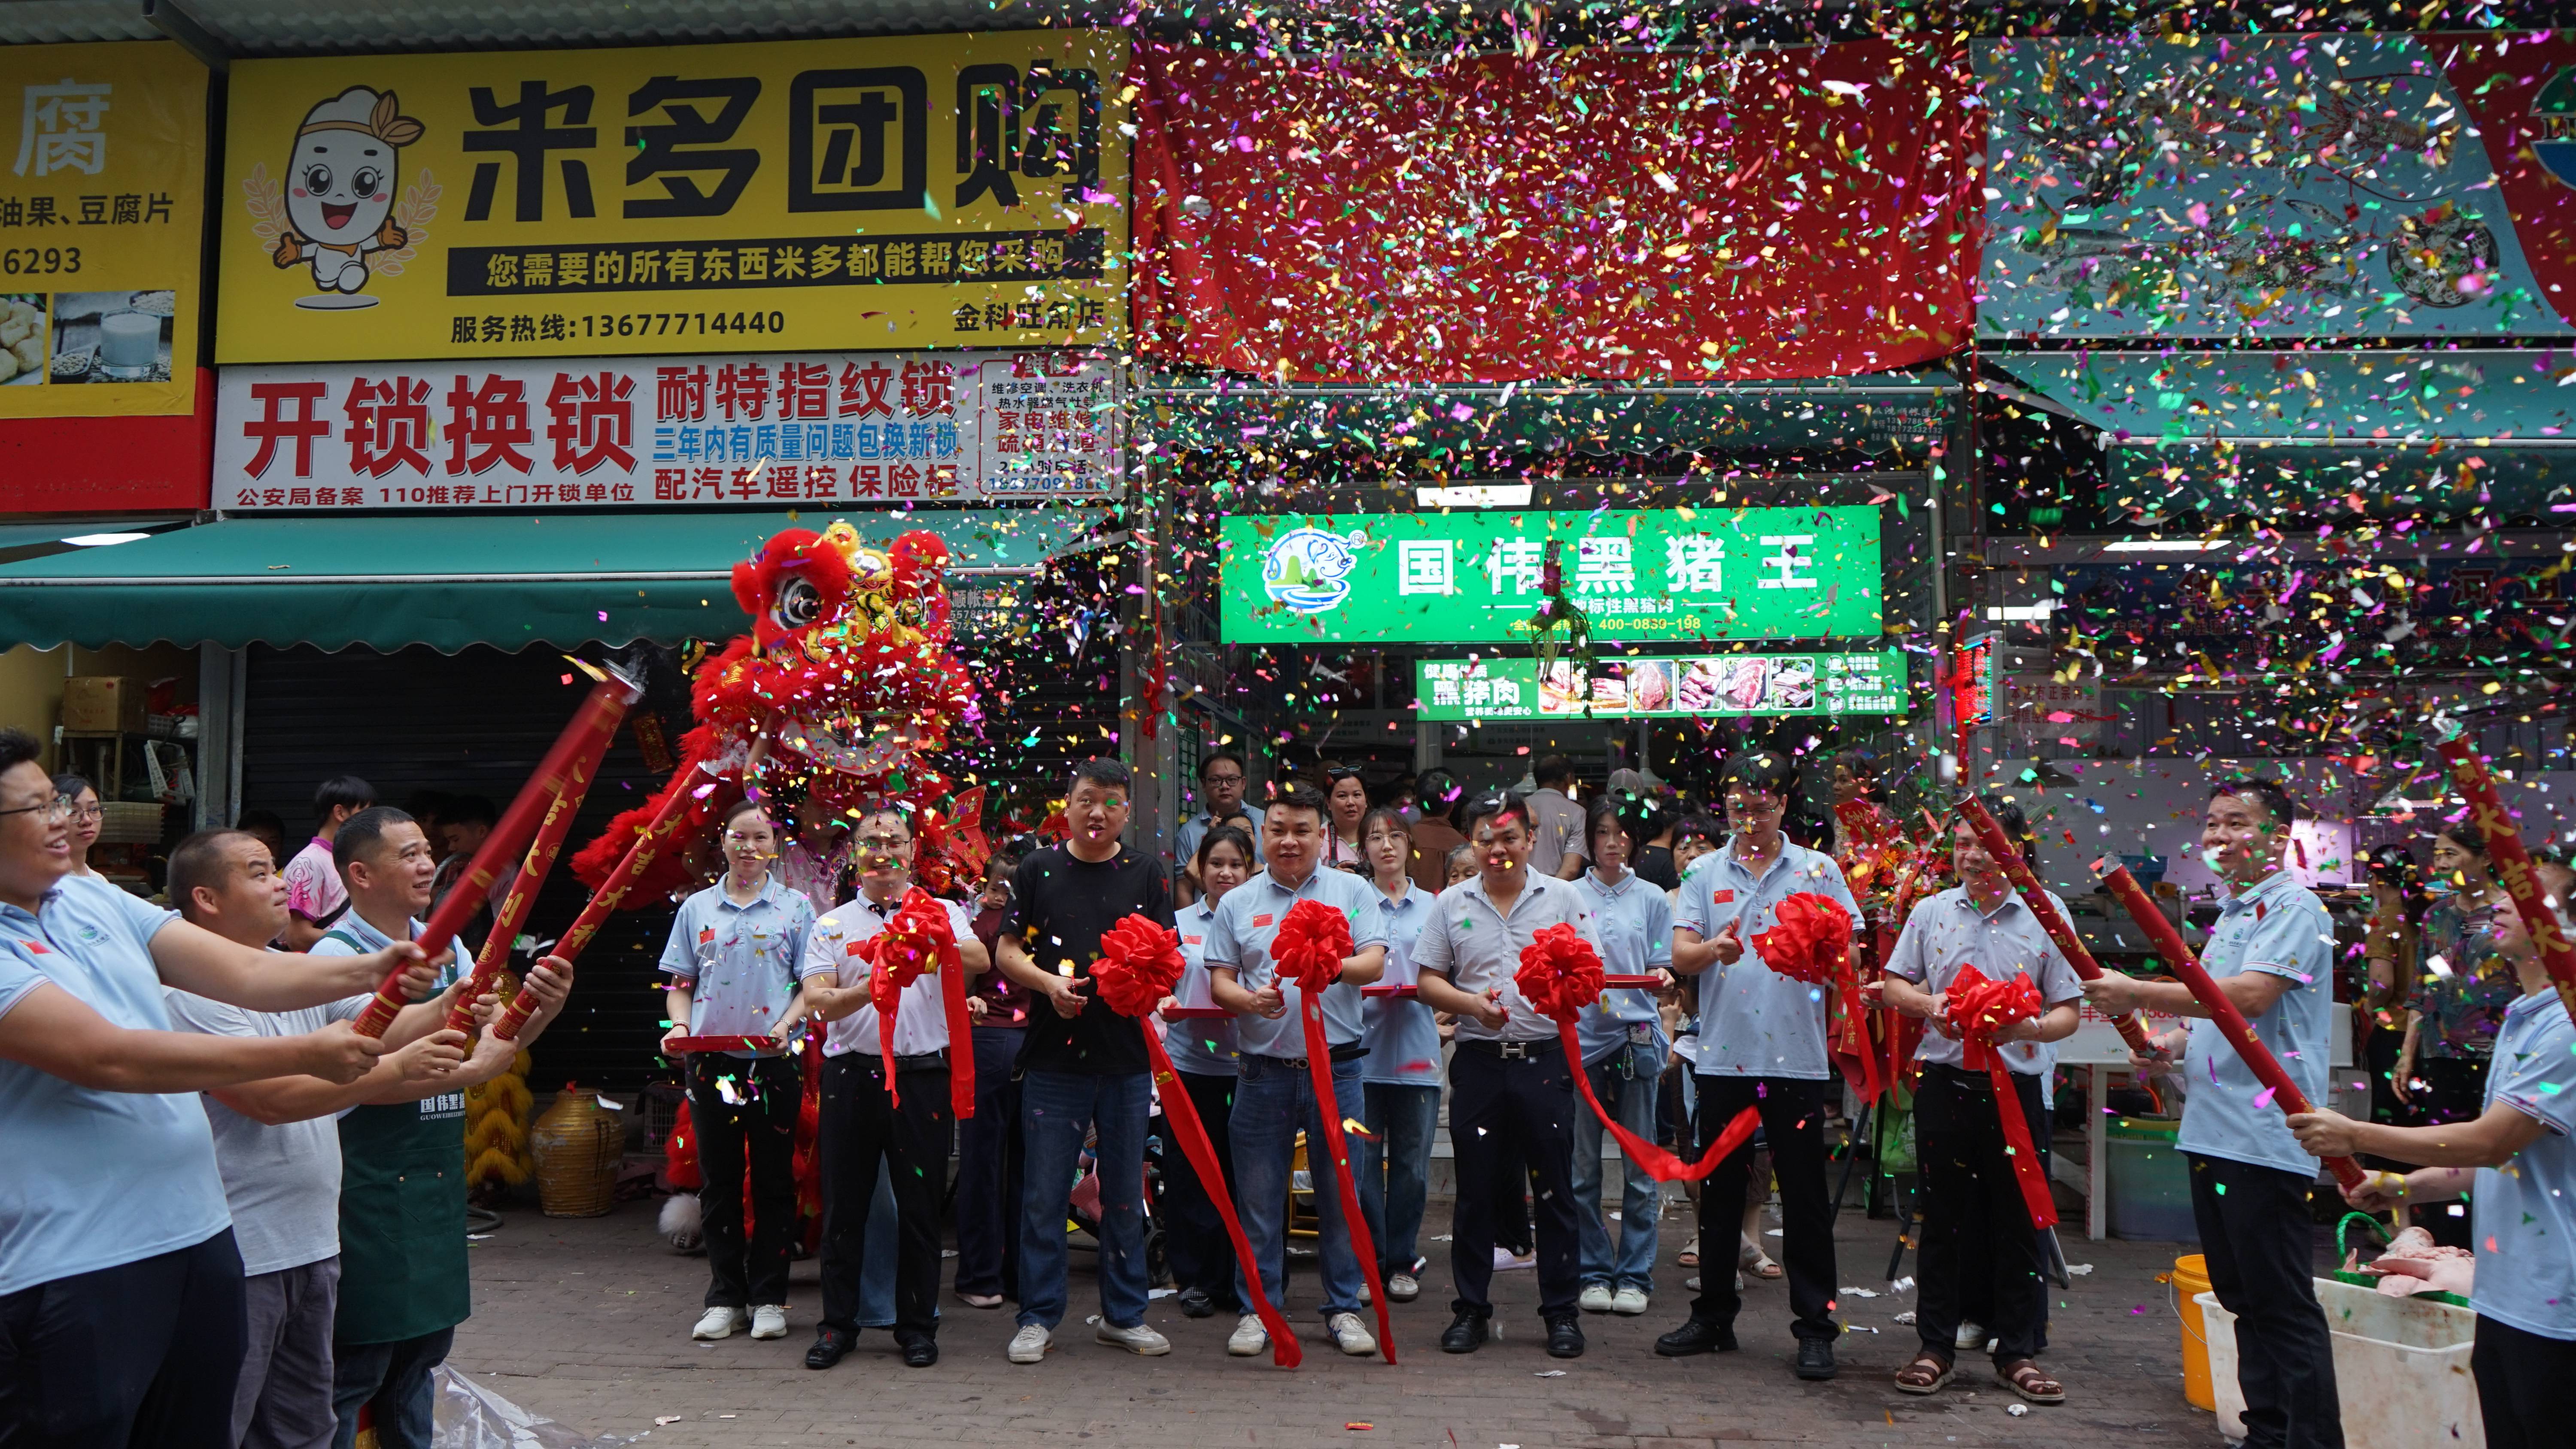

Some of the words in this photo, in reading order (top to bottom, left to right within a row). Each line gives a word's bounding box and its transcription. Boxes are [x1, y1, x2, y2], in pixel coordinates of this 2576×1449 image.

[13, 77, 112, 178] 腐
[462, 58, 1099, 222] 米多团购
[0, 192, 173, 228] 油果、豆腐片
[4, 247, 81, 275] 6293
[486, 237, 1064, 287] 您需要的所有东西米多都能帮您采购
[656, 360, 956, 422] 耐特指纹锁
[244, 372, 637, 480] 开锁换锁
[653, 422, 958, 462] 三年内有质量问题包换新锁
[237, 487, 365, 506] 公安局备案
[380, 483, 635, 505] 110推荐上门开锁单位
[655, 465, 838, 501] 配汽车遥控
[849, 464, 959, 499] 保险柜
[1398, 534, 1818, 596] 国伟黑猪王
[1433, 679, 1520, 706] 黑猪肉
